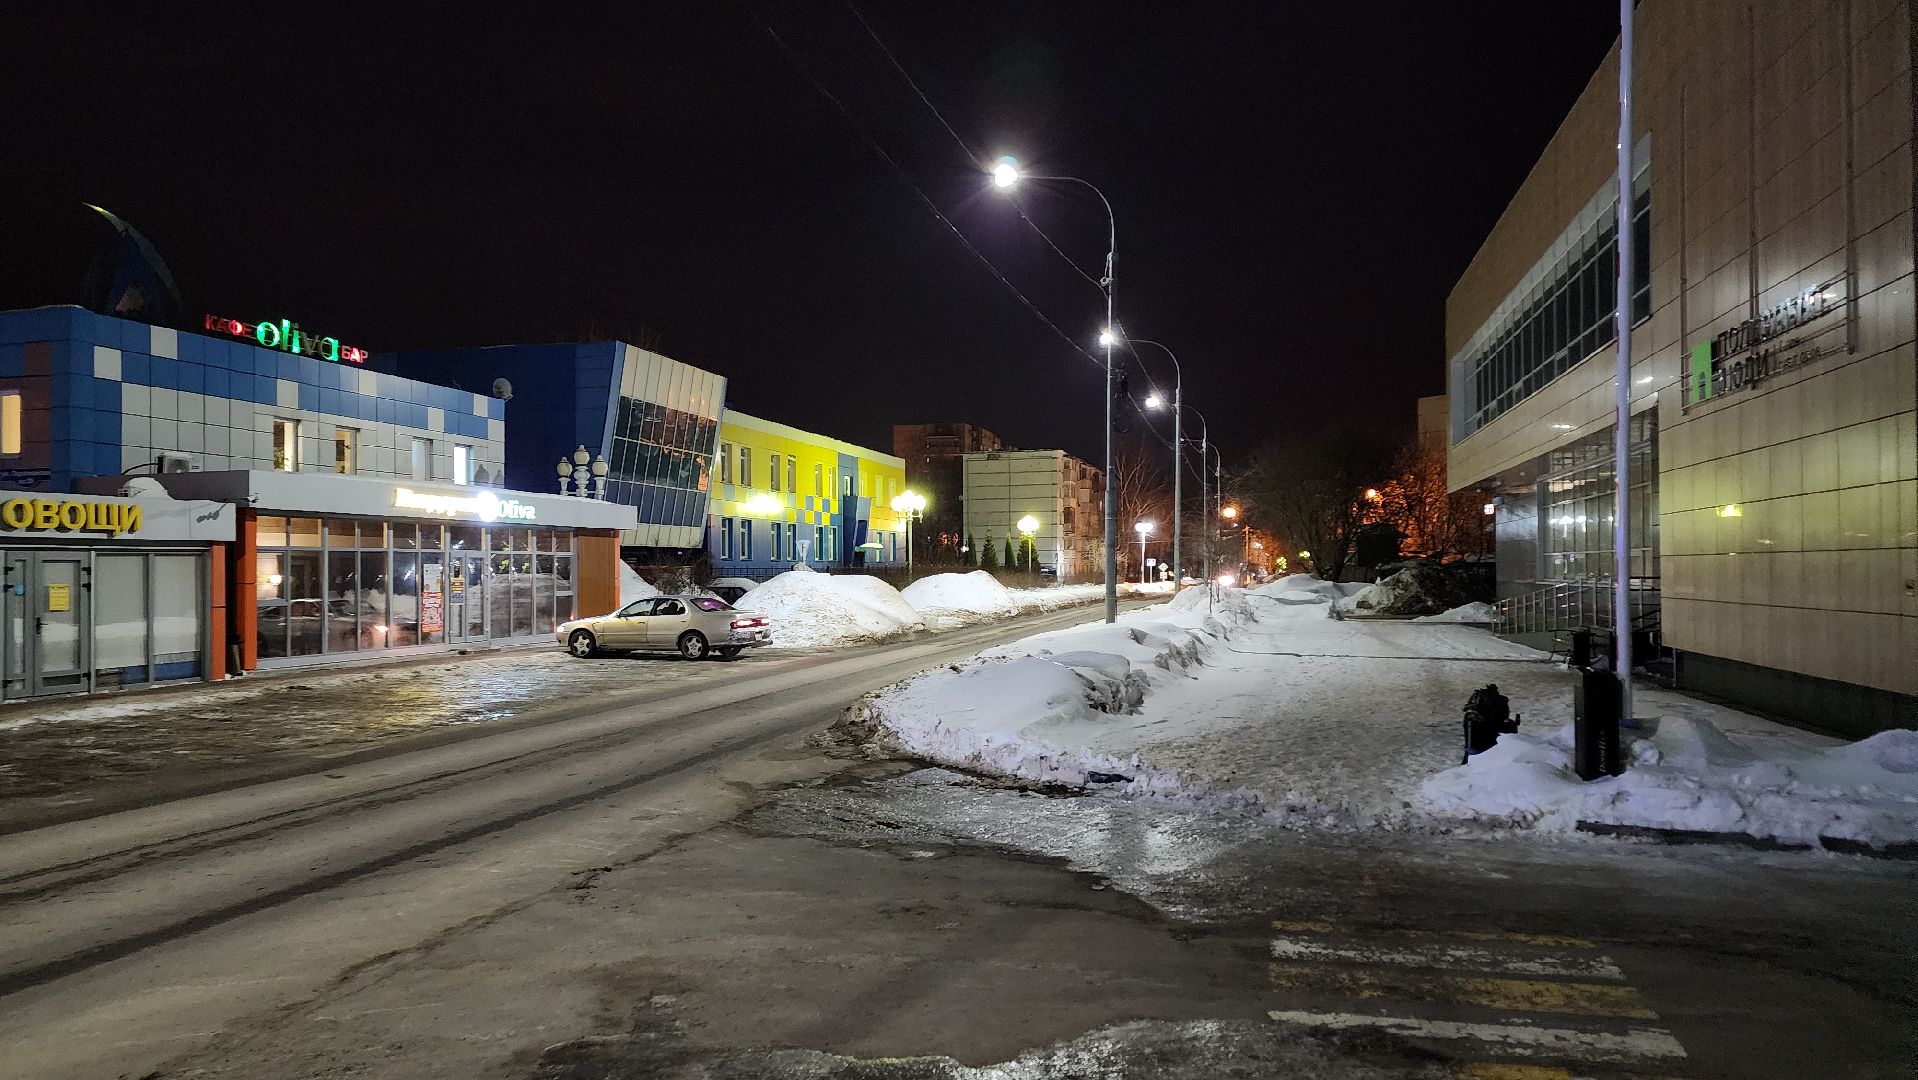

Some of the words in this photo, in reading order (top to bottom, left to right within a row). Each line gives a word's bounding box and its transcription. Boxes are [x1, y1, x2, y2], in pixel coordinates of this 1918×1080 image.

[256, 318, 340, 362] oliva
[341, 345, 369, 364] БАР
[3, 498, 143, 537] ОВОЩИ
[499, 499, 537, 520] Oliva
